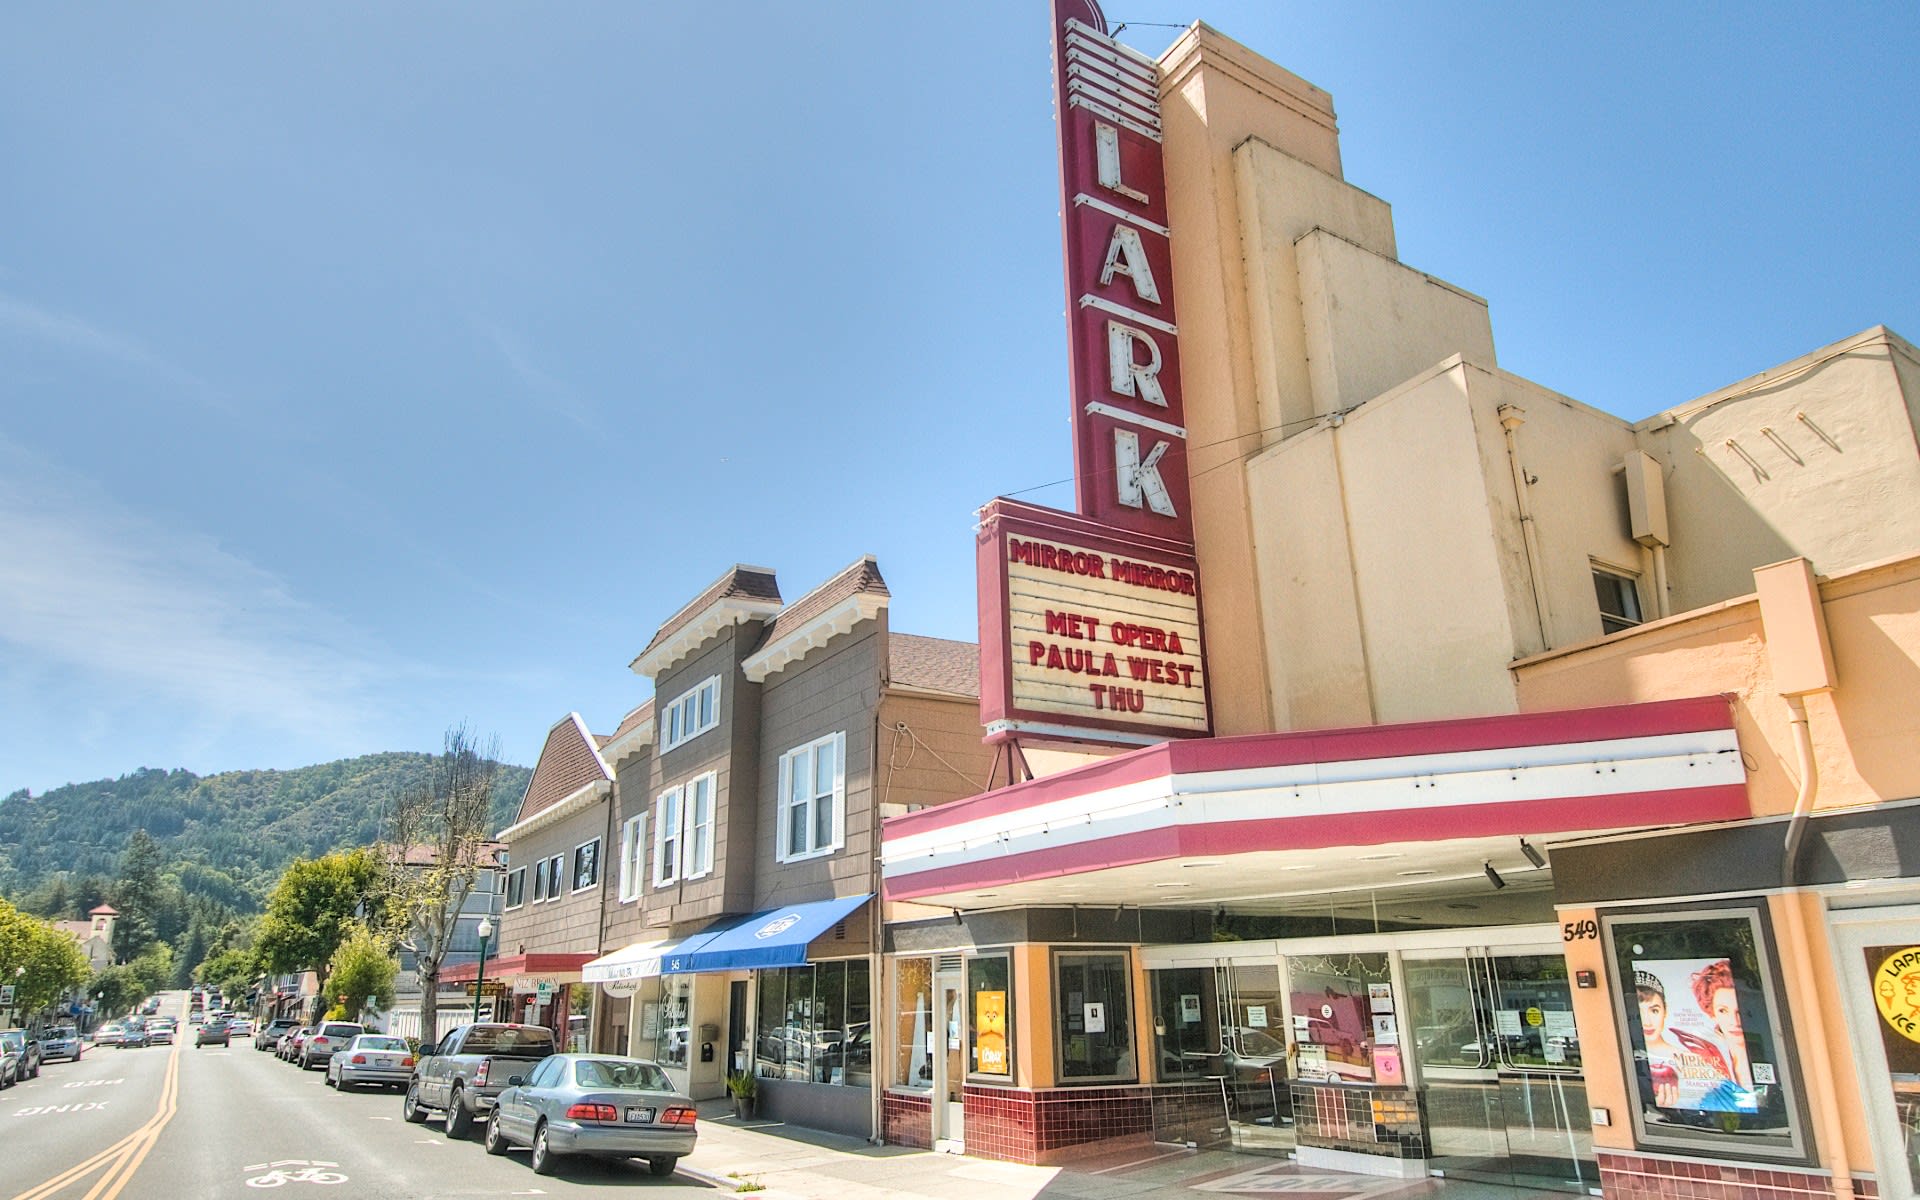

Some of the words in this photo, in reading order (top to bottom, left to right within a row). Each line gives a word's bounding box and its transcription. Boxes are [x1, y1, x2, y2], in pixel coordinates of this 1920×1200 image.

[1095, 119, 1178, 518] LARK
[1010, 538, 1105, 579] MIRROR
[1111, 558, 1195, 596] MIRROR
[1046, 610, 1099, 641] MET
[1111, 621, 1184, 655] OPERA
[1029, 640, 1119, 678] PAULA
[1127, 655, 1194, 688] WEST
[1089, 683, 1144, 713] THU
[1564, 919, 1598, 941] 549
[671, 959, 680, 971] 545
[1892, 1013, 1916, 1034] ICE
[12, 1101, 110, 1117] XING
